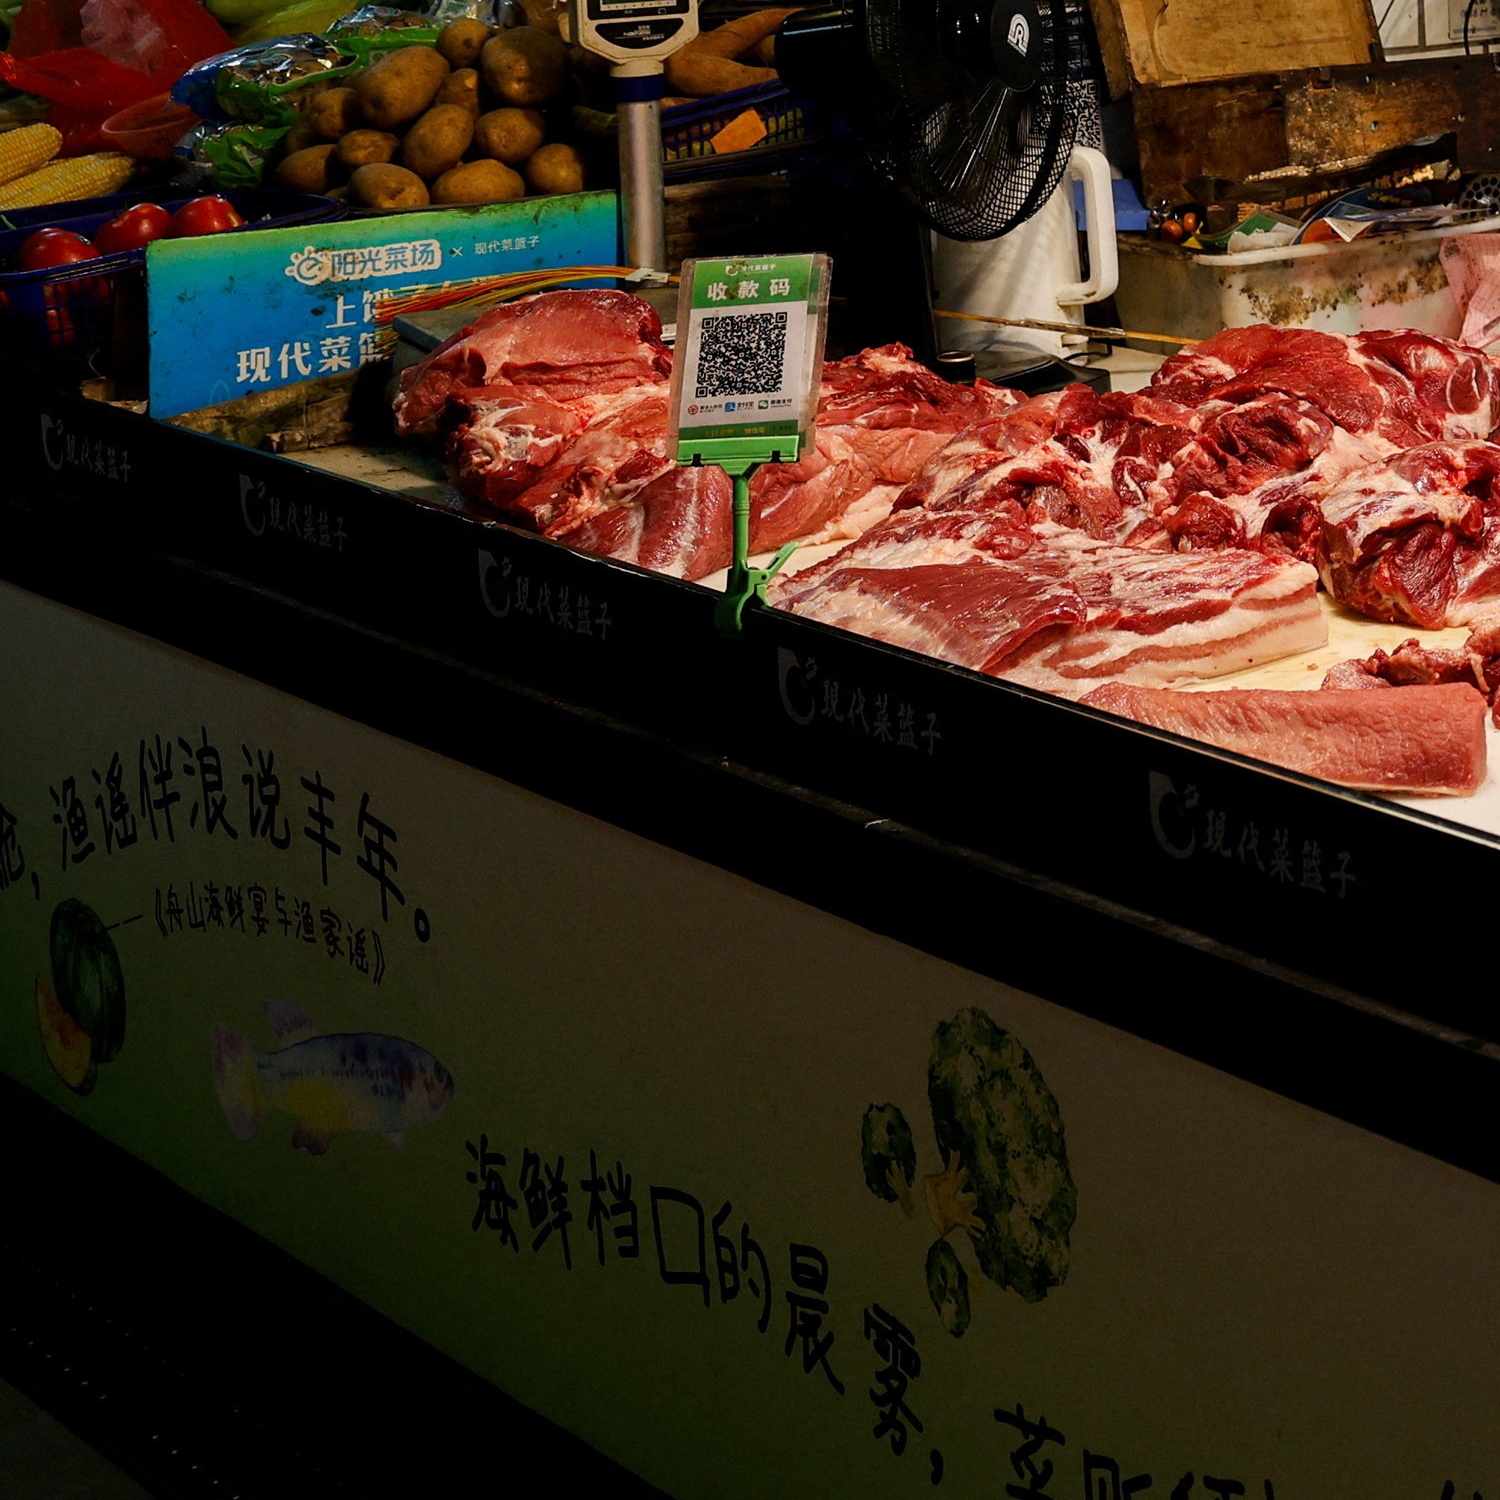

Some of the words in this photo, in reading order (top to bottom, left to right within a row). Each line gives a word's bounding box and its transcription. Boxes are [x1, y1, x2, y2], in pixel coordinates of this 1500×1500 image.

[331, 242, 436, 278] 阳光菜场
[474, 235, 541, 256] 现代菜篮子
[707, 278, 791, 302] 收款码
